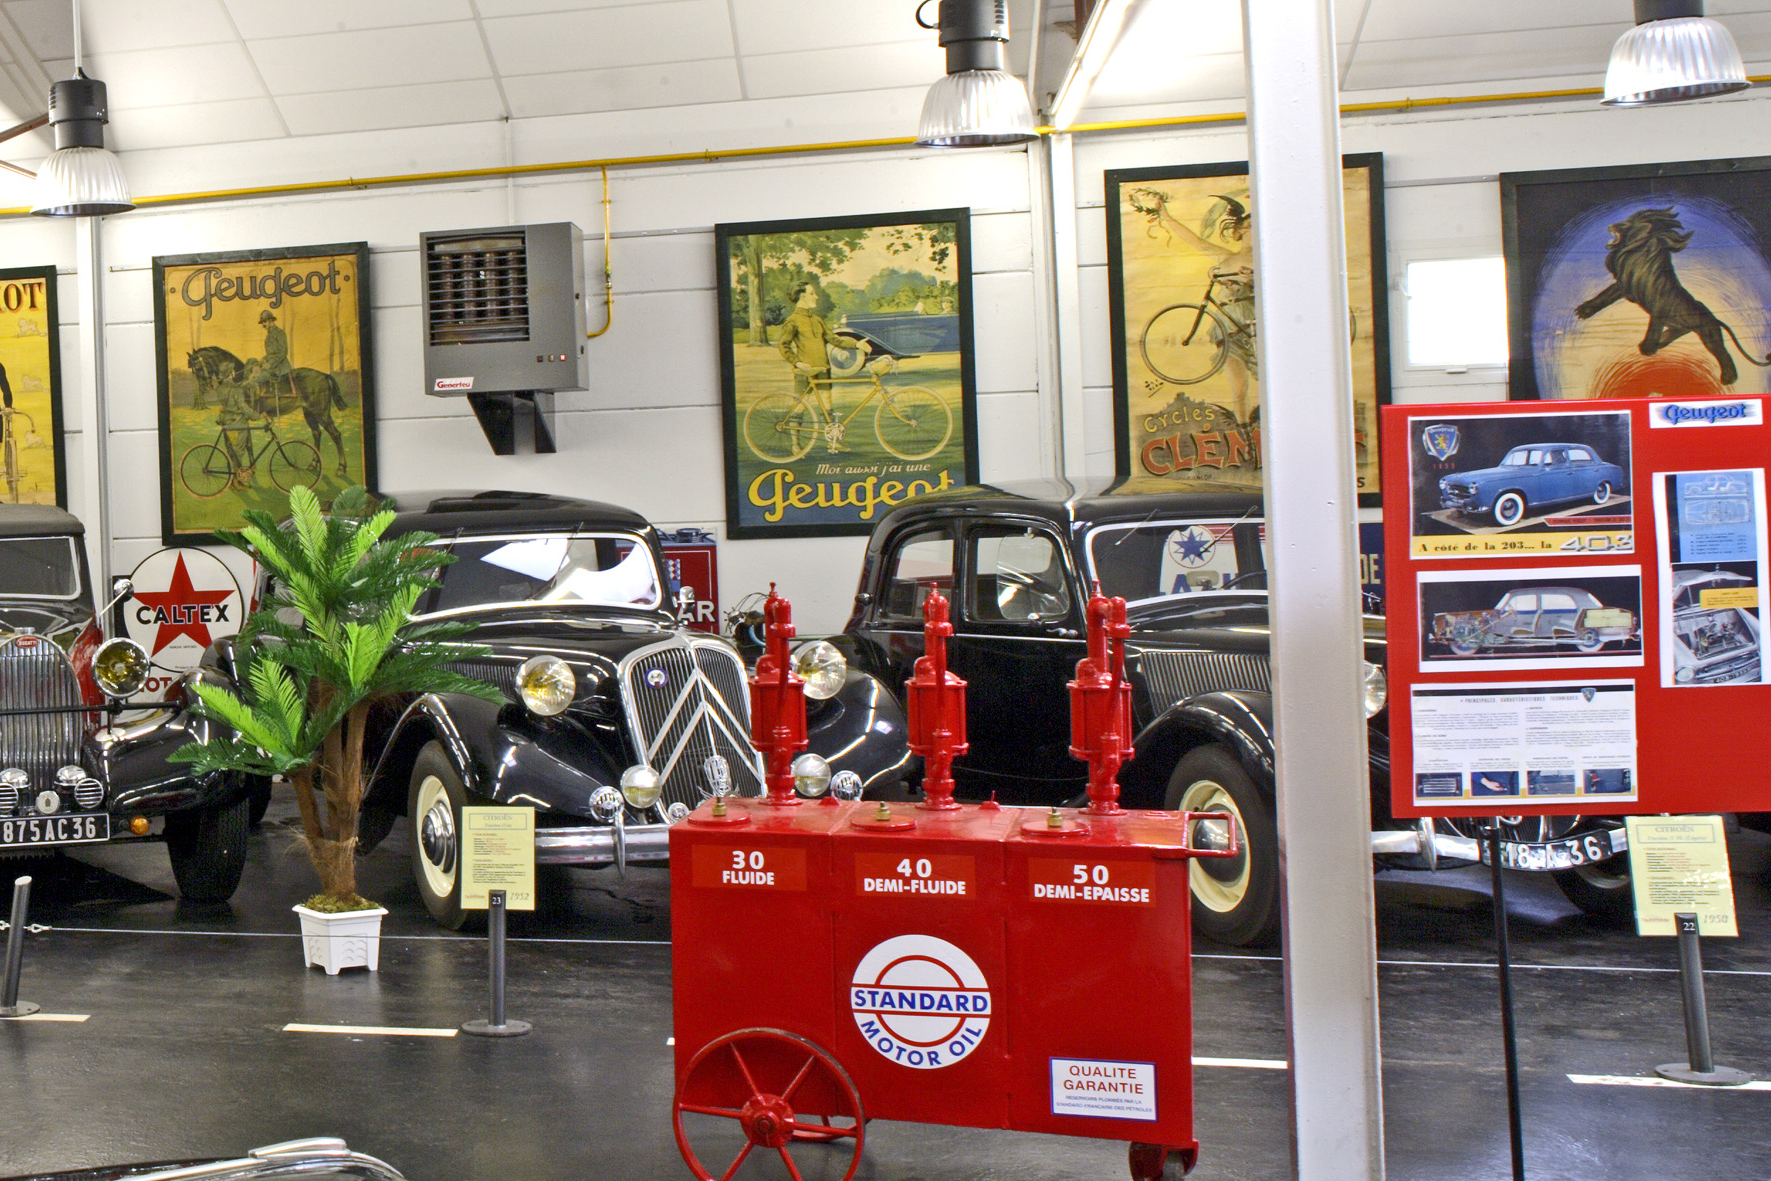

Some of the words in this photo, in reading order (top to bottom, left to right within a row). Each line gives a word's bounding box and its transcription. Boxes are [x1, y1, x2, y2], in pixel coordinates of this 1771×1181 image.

[182, 260, 341, 321] Peugeot
[1144, 406, 1215, 433] Cycles
[1661, 403, 1747, 426] Peugeot
[816, 463, 842, 476] Moi
[906, 463, 931, 473] une
[1434, 542, 1458, 552] côté
[1464, 541, 1478, 552] de
[1484, 541, 1496, 551] la
[1540, 540, 1553, 550] la
[1559, 535, 1633, 553] 403
[135, 603, 230, 625] CALTEX
[731, 850, 765, 870] 30
[896, 858, 933, 878] 40
[722, 870, 775, 886] FLUIDE
[1073, 864, 1109, 885] 50
[863, 877, 967, 896] DEMI-FLUIDE
[1033, 883, 1150, 903] DEMI-EPAISSE
[492, 896, 502, 905] 23
[1683, 922, 1696, 931] 22
[854, 989, 988, 1013] STANDARD
[860, 1020, 942, 1066] MOTOR
[948, 1027, 983, 1057] OIL
[1069, 1065, 1137, 1079] QUALITE
[1063, 1079, 1144, 1095] GARANTIE
